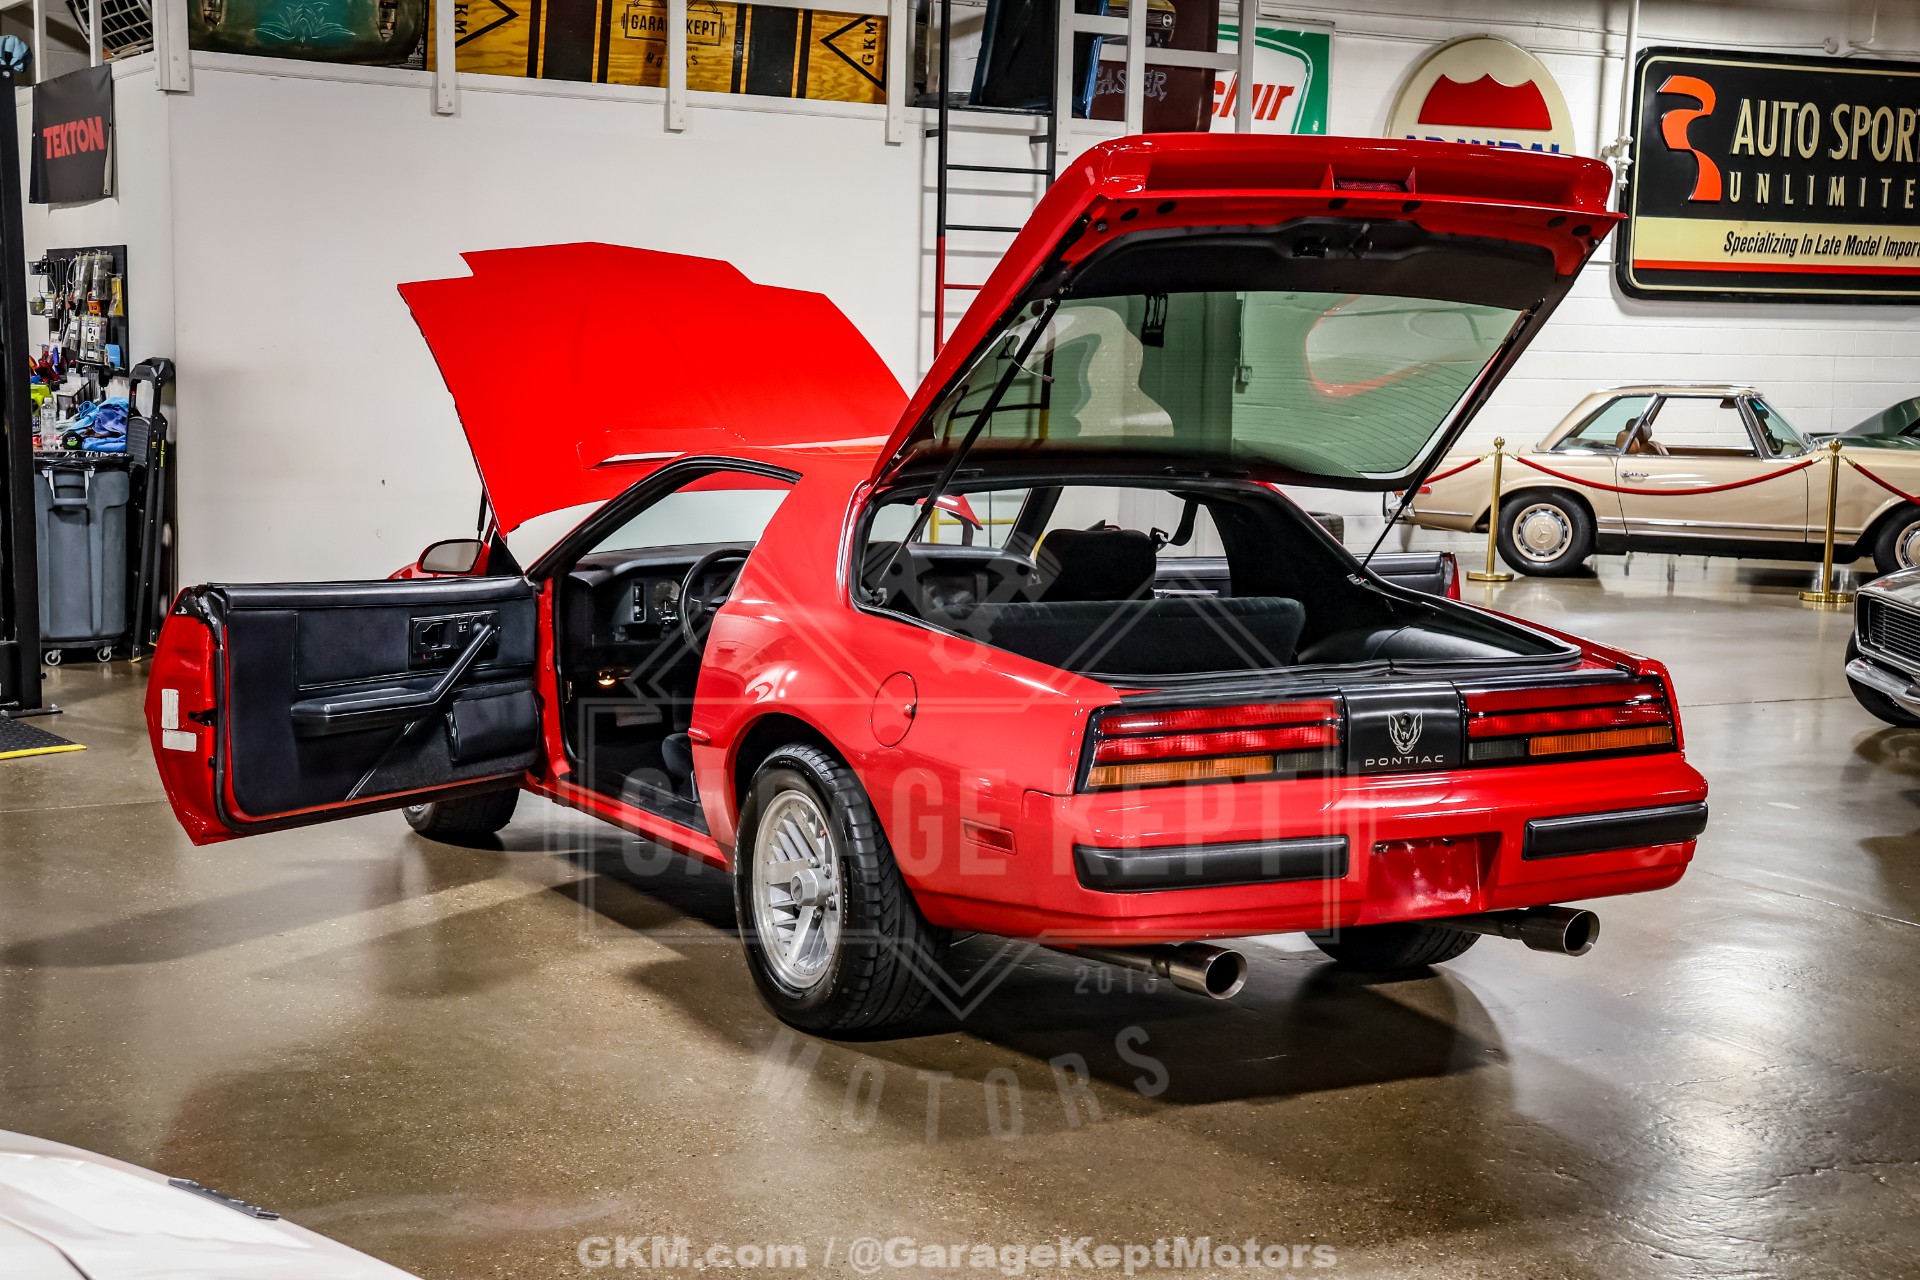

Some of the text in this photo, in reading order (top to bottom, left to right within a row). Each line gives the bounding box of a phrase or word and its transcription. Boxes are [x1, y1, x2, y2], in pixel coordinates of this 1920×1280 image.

[631, 14, 717, 36] GARA KEPT
[862, 21, 877, 66] GKM
[43, 115, 105, 159] TEKTON
[1732, 98, 1920, 163] AUTO SPOR
[1729, 171, 1916, 209] UNLIMITE
[1724, 231, 1799, 257] Specializing
[1800, 234, 1813, 254] In
[1814, 234, 1842, 255] Late
[1843, 235, 1882, 256] Model
[1365, 755, 1444, 767] PONTIAC
